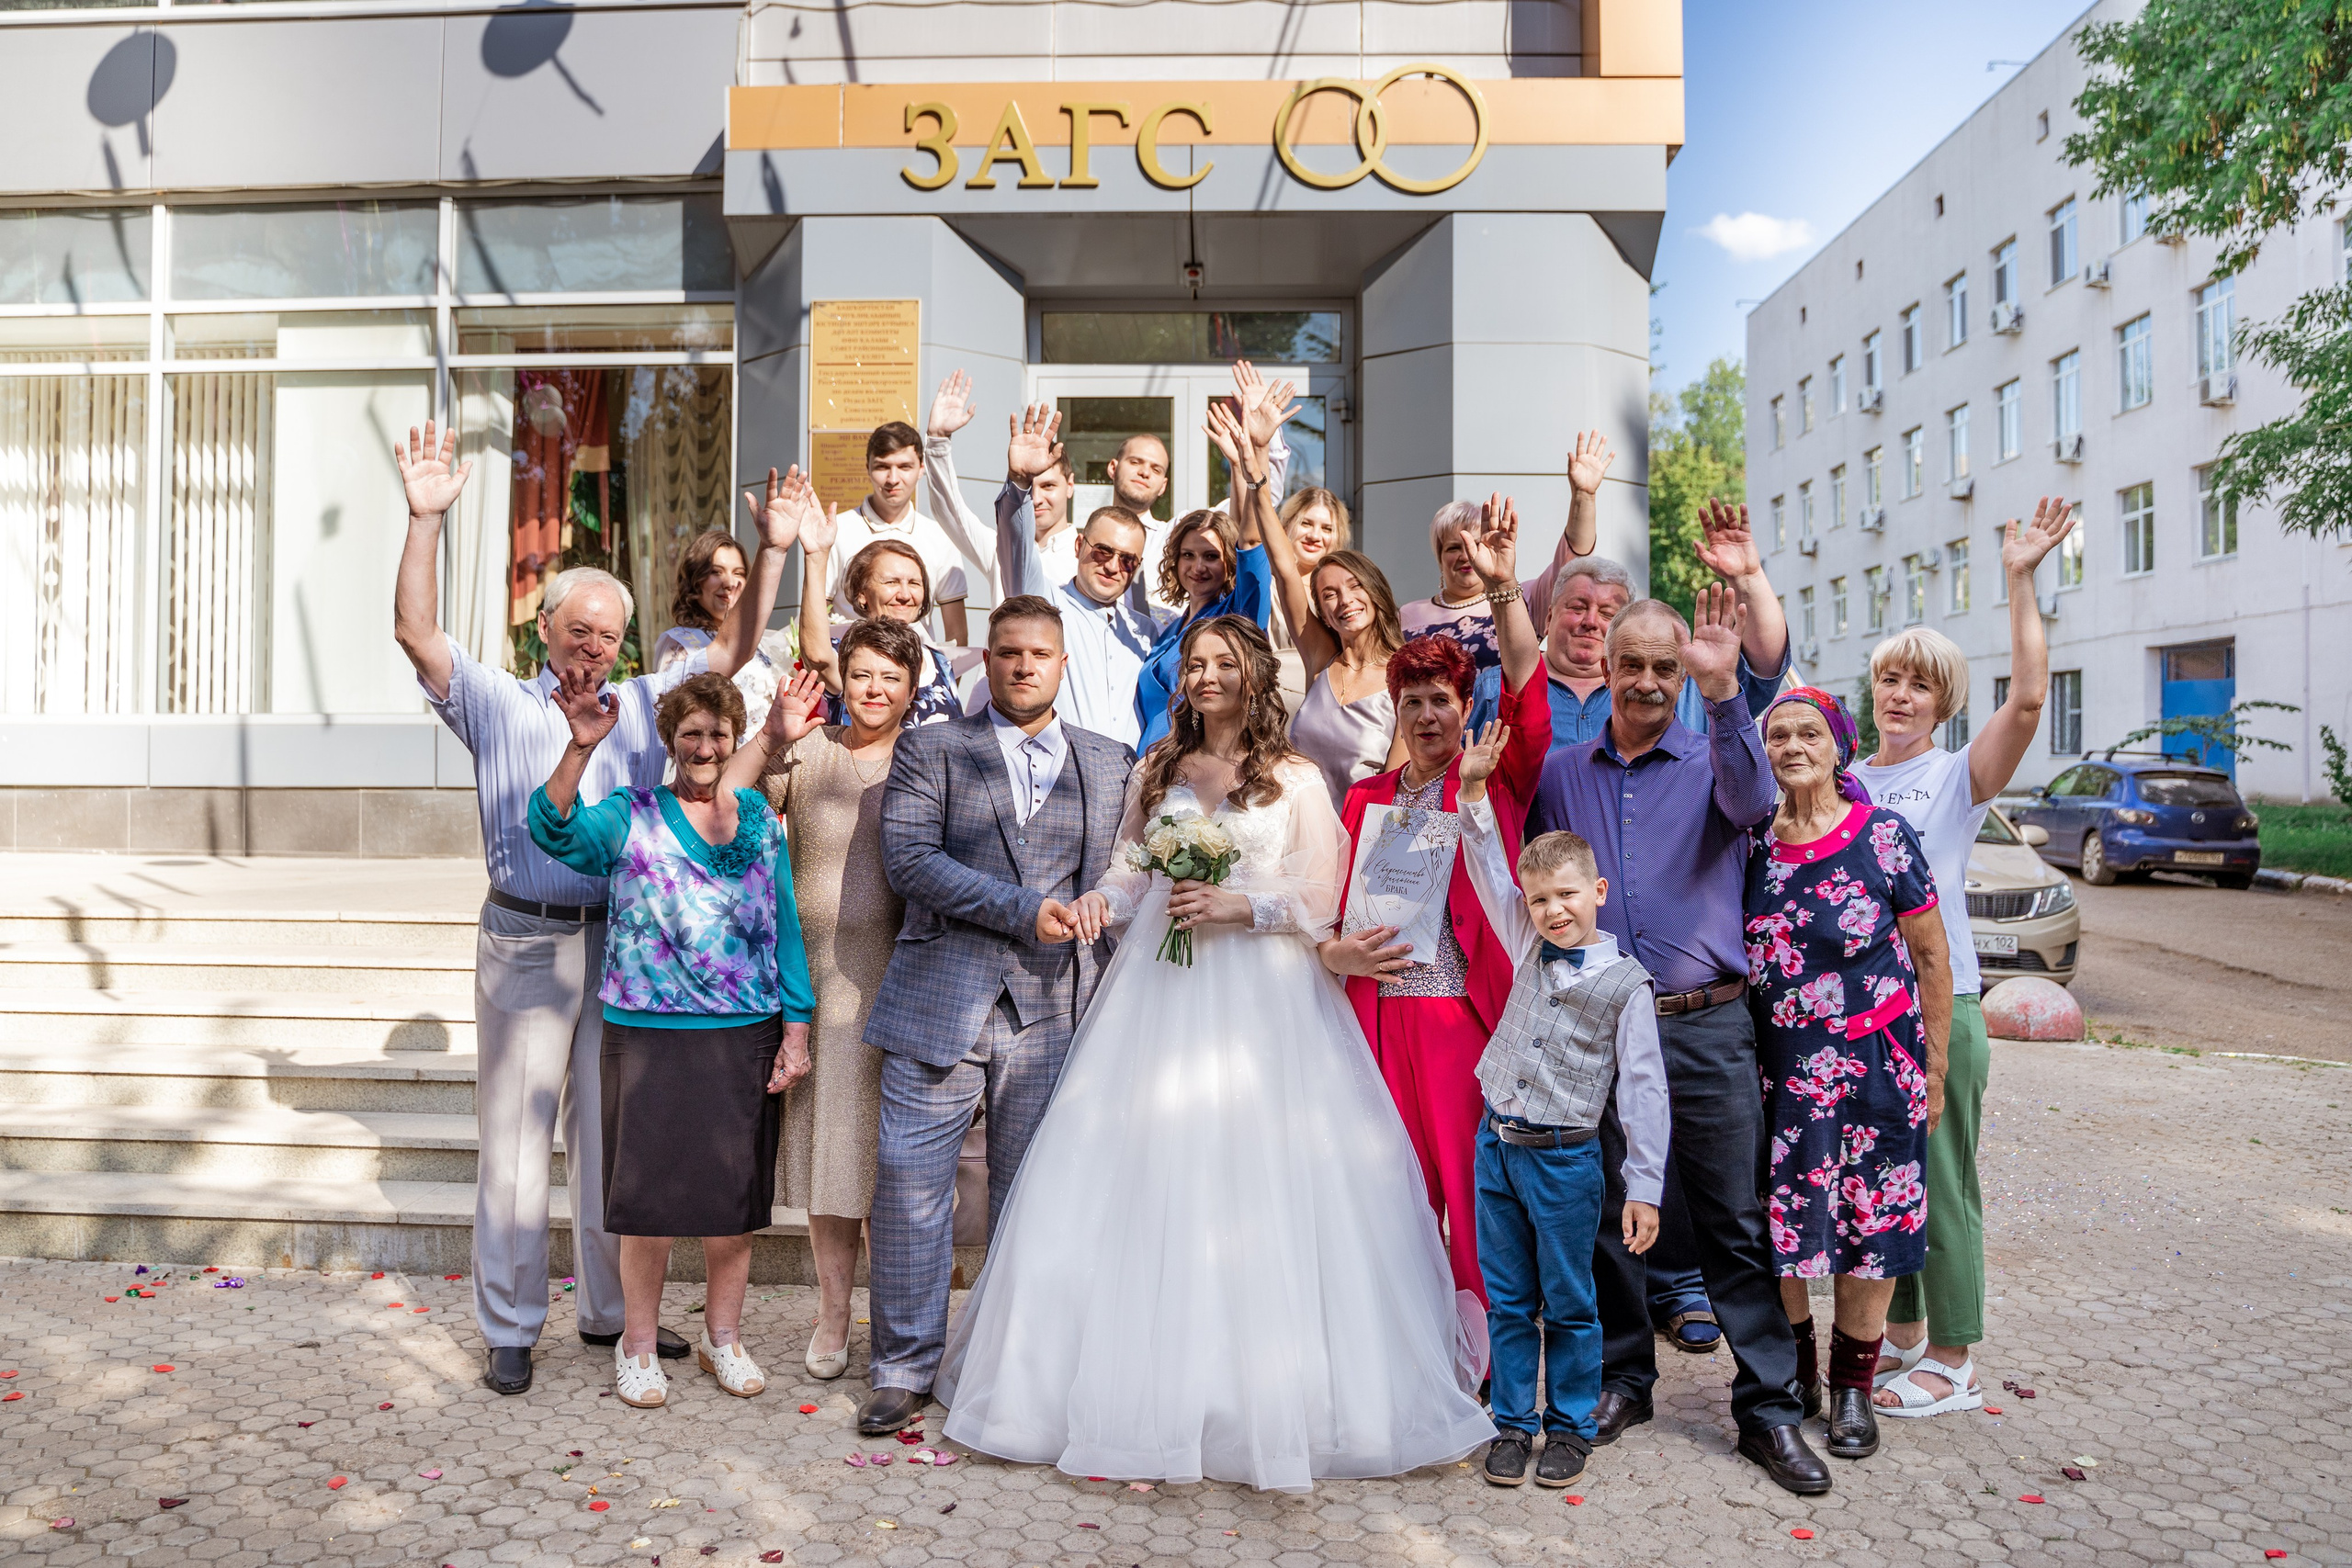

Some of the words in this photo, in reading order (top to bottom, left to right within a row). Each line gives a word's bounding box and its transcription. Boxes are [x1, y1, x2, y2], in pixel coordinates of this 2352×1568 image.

[900, 100, 1214, 191] ЗАГС
[1385, 885, 1408, 895] БРАКА
[1994, 936, 2015, 948] 102
